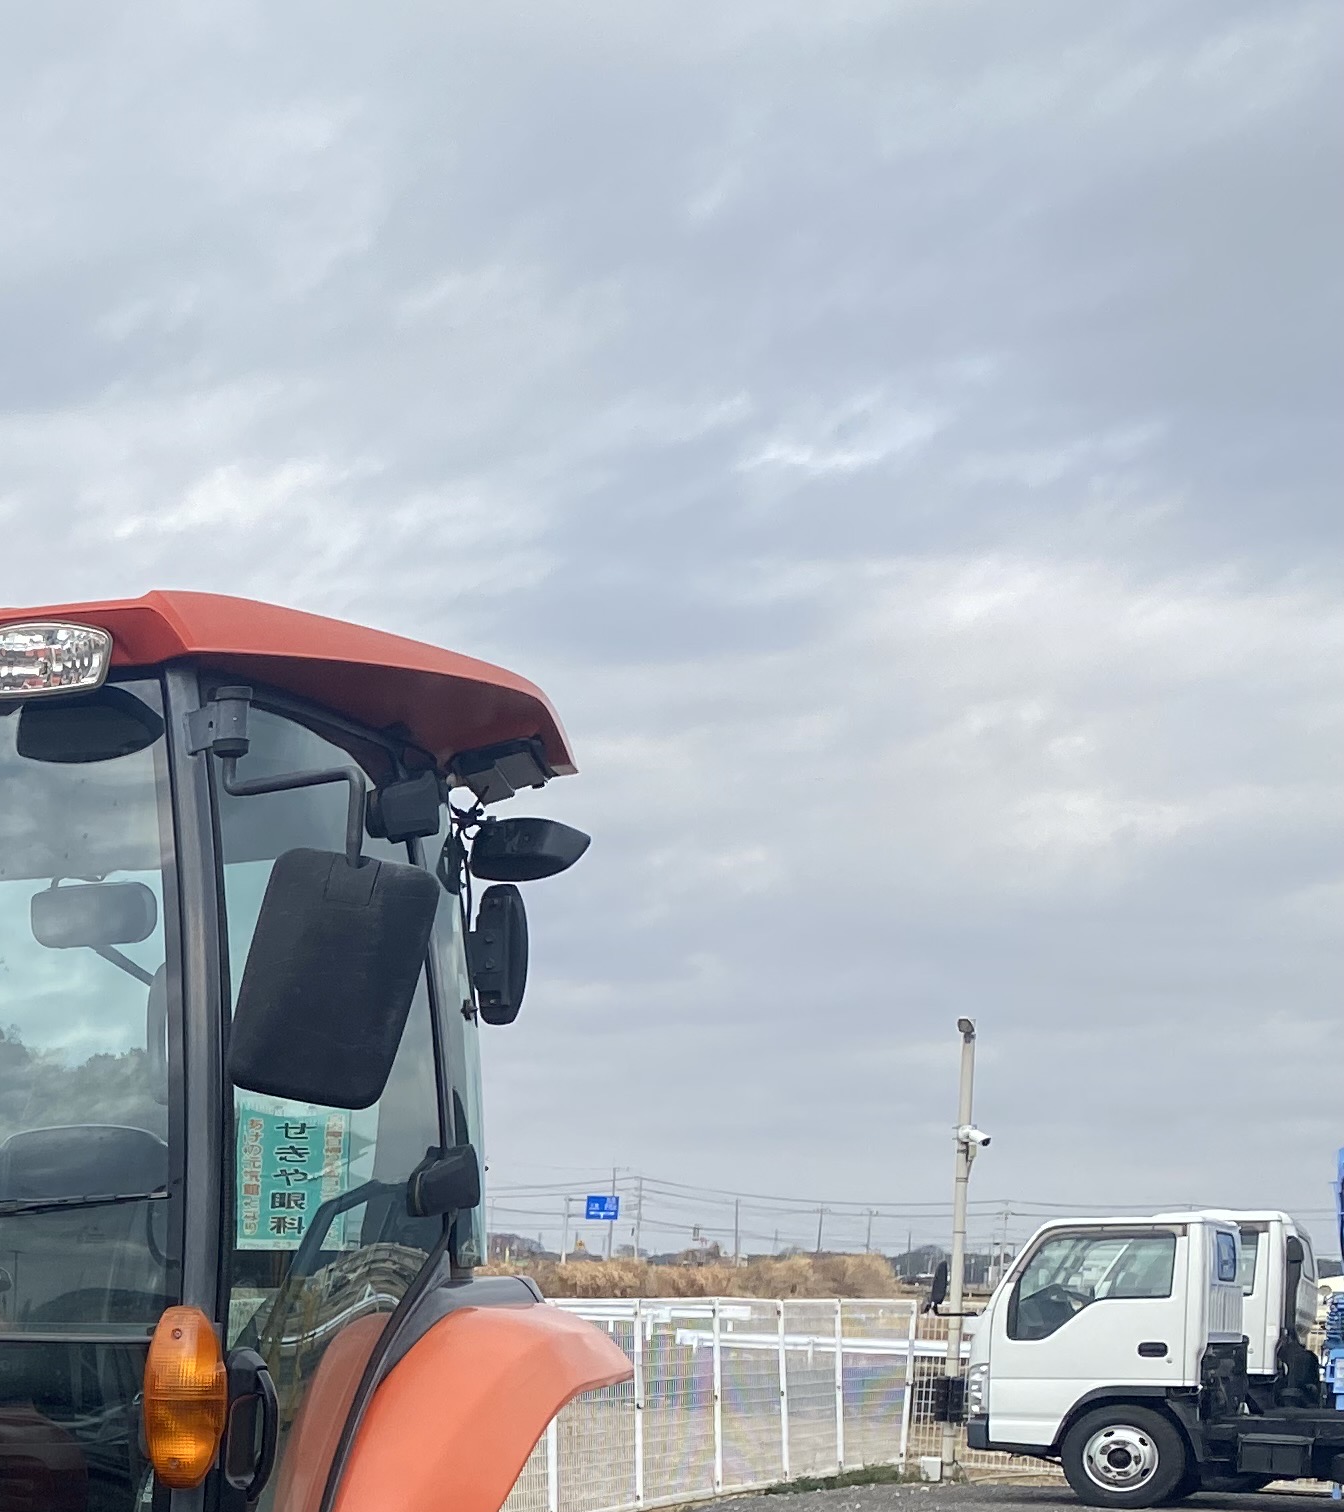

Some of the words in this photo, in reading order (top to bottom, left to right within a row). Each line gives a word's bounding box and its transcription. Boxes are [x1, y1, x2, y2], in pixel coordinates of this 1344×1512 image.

[269, 1122, 317, 1235] せきや眼科
